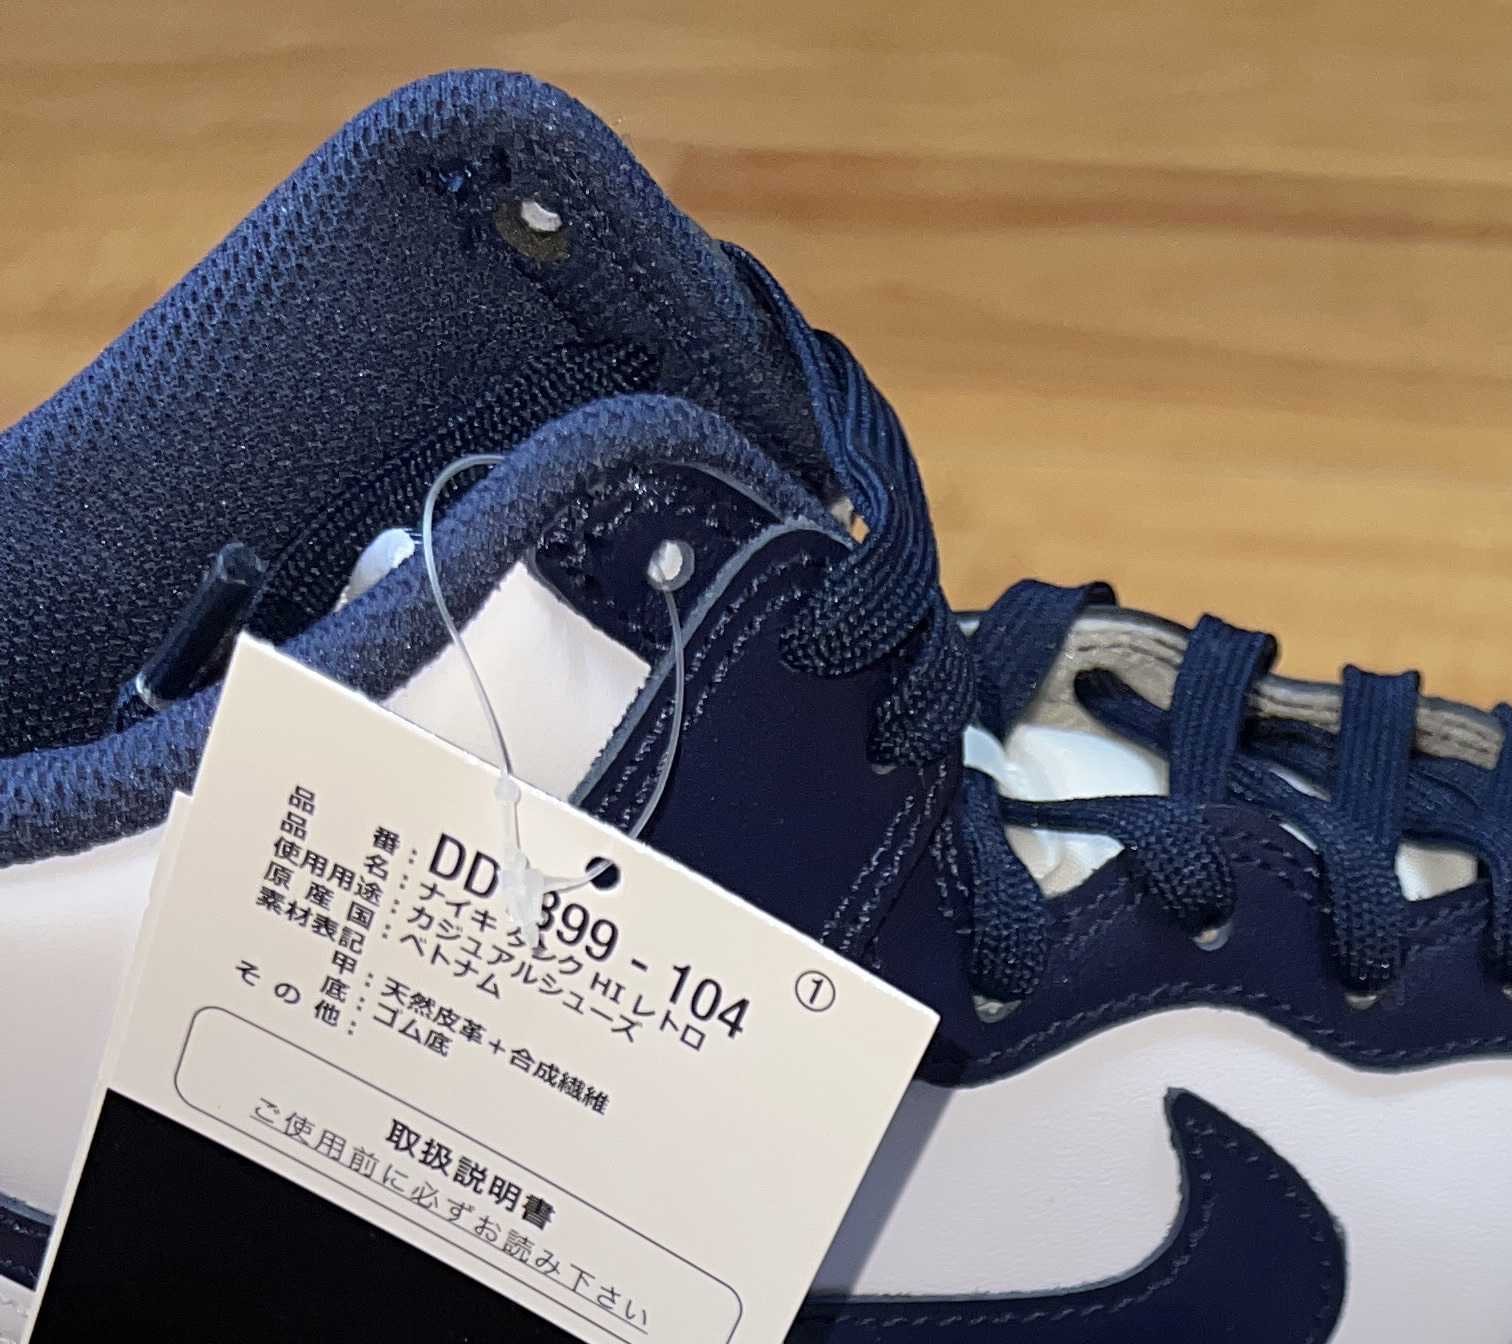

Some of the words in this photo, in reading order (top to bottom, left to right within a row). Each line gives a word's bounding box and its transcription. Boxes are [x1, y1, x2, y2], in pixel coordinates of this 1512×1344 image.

[256, 885, 365, 956] 素材表記
[400, 933, 501, 1000] ベトナム
[373, 1002, 454, 1058] ゴム底
[590, 971, 627, 1004] HI
[632, 994, 707, 1051] レトロ
[385, 1117, 557, 1232] 取扱説明書
[250, 1096, 650, 1330] ご使用前に必ずお読み下さい
